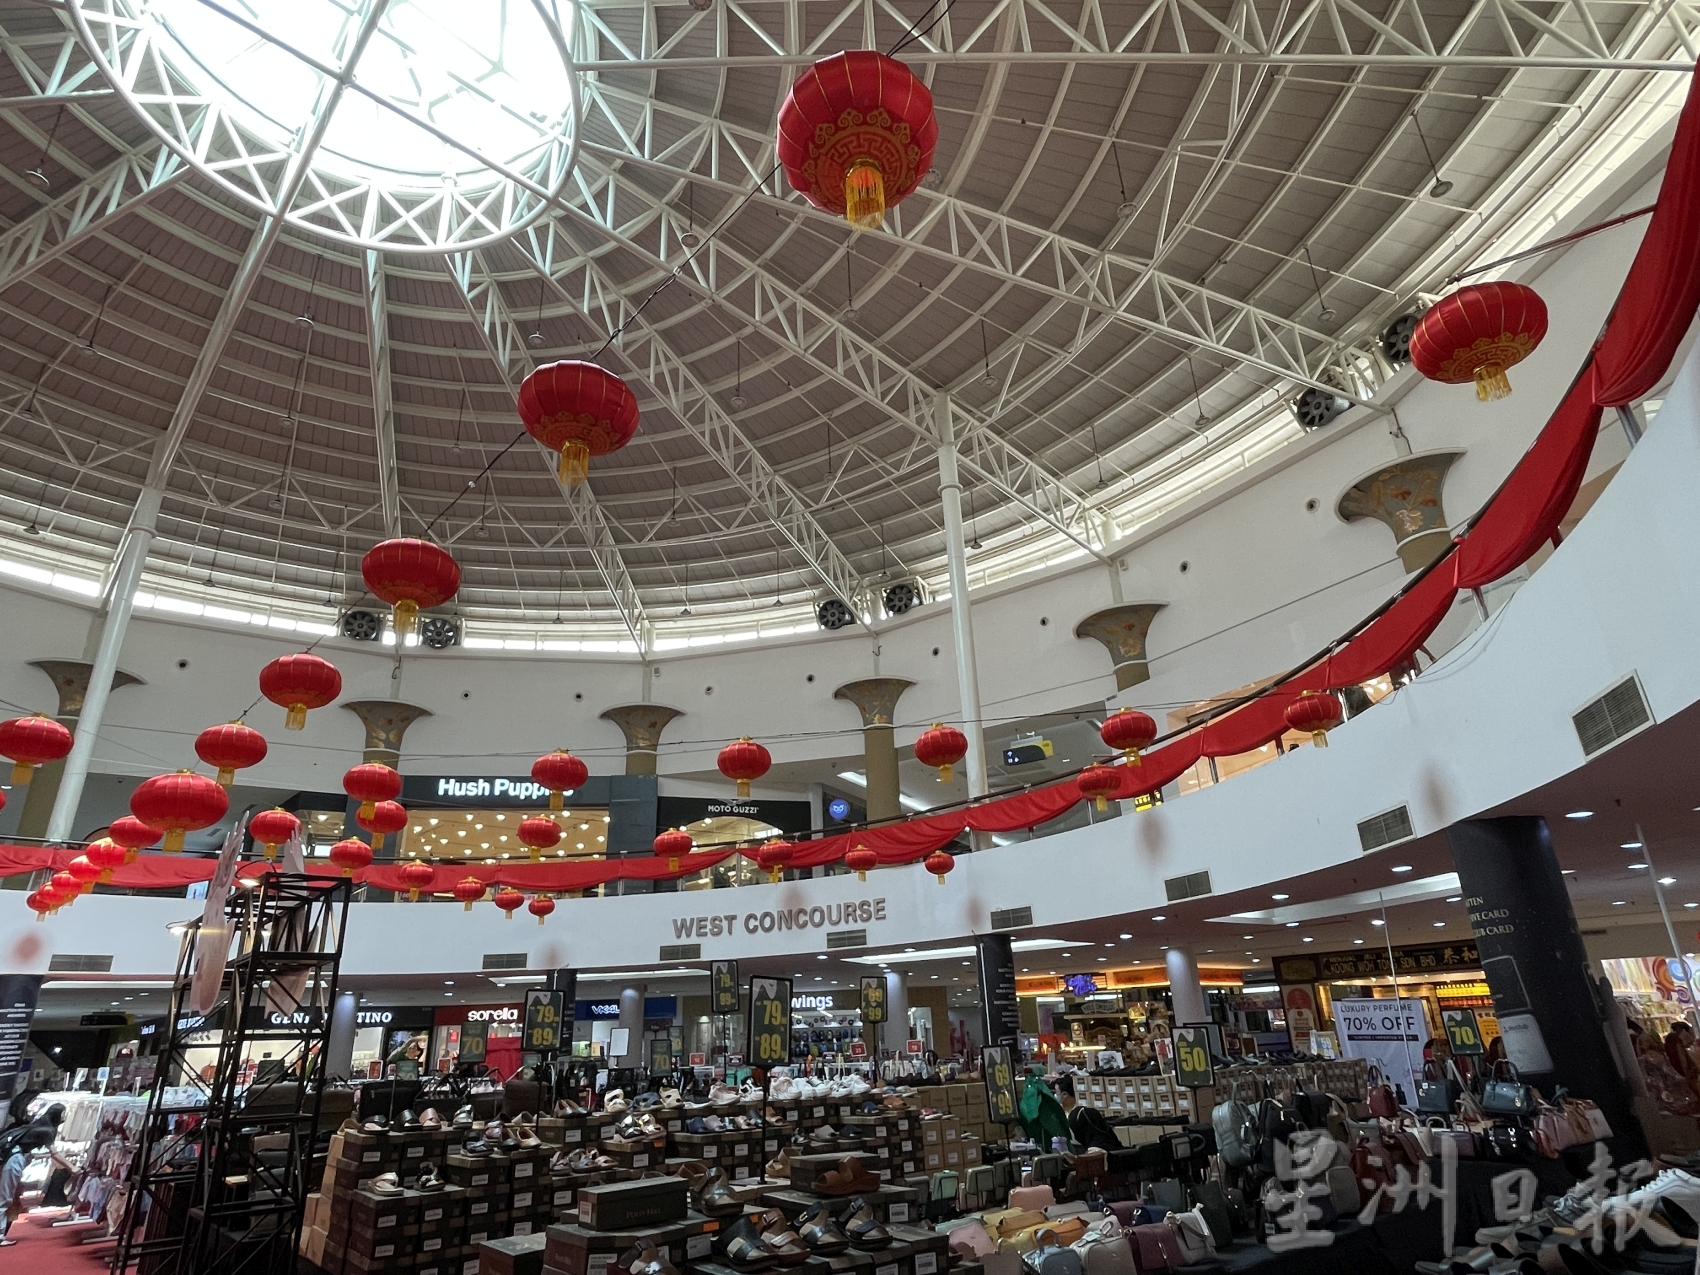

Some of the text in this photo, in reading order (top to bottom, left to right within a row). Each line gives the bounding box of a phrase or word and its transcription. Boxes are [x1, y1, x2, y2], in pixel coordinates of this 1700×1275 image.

[438, 778, 490, 796] Hush
[672, 897, 887, 939] WEST CONCOURSE
[1482, 909, 1509, 920] CARD
[1486, 924, 1515, 936] CARD
[1330, 962, 1355, 974] KOONG
[1358, 960, 1375, 972] WOH
[1420, 955, 1436, 967] BHD
[467, 1007, 519, 1022] sorella
[536, 1005, 555, 1023] 79
[763, 1000, 782, 1025] 79
[1340, 1003, 1413, 1013] LUXURY PERFUME
[1343, 1016, 1415, 1031] 70% OFF
[532, 1027, 553, 1046] 89
[1450, 1026, 1475, 1045] 70
[462, 1036, 484, 1055] 70
[760, 1033, 782, 1060] 89
[652, 1054, 669, 1070] 70
[1179, 1046, 1206, 1072] 50
[994, 1064, 1010, 1087] 69
[997, 1094, 1013, 1115] 99
